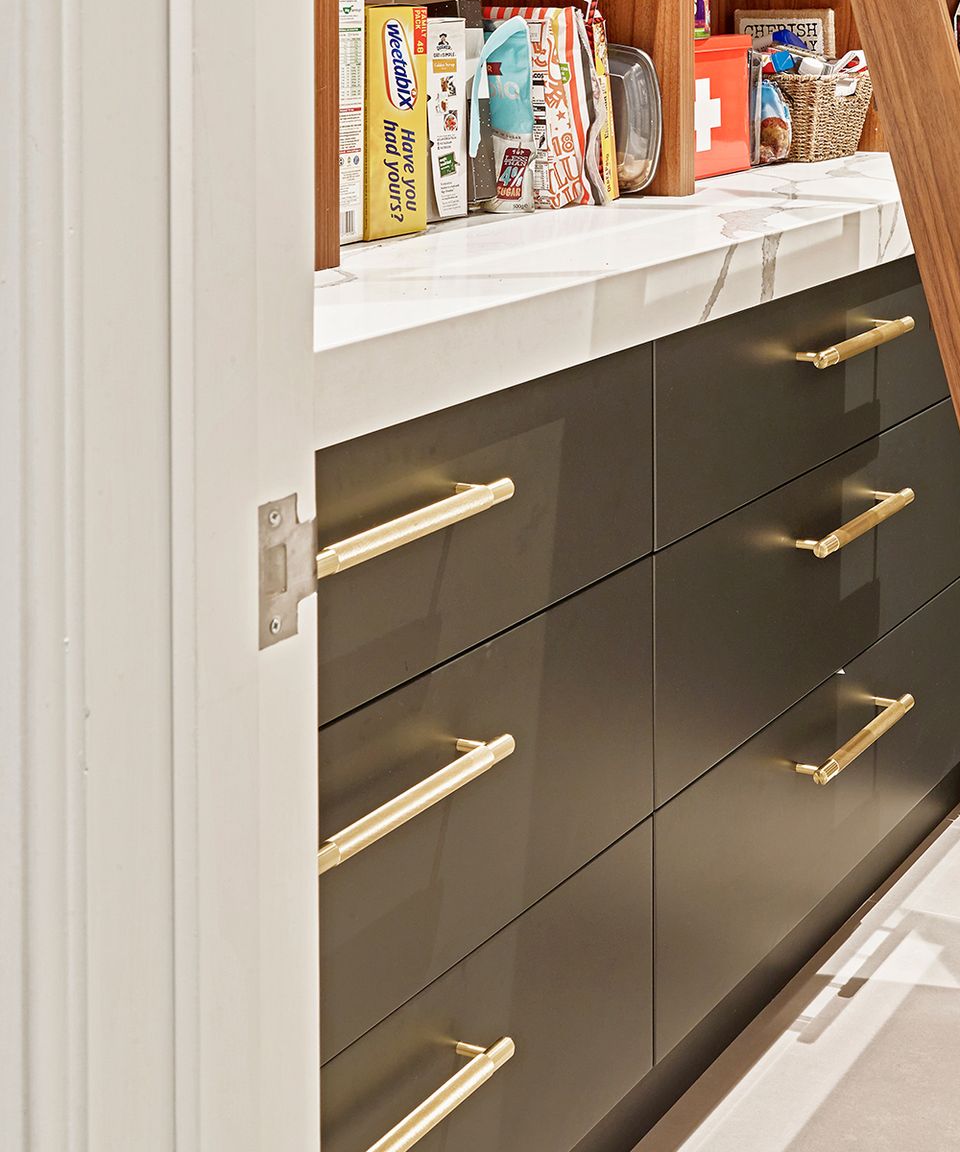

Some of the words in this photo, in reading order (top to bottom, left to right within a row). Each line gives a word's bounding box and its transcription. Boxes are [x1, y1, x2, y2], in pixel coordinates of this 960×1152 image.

[386, 22, 414, 111] Weetabix
[382, 119, 399, 156] had
[400, 128, 416, 173] Have
[383, 159, 404, 223] yours?
[405, 176, 417, 211] you
[496, 186, 521, 196] SUGAR
[499, 166, 524, 188] 4%
